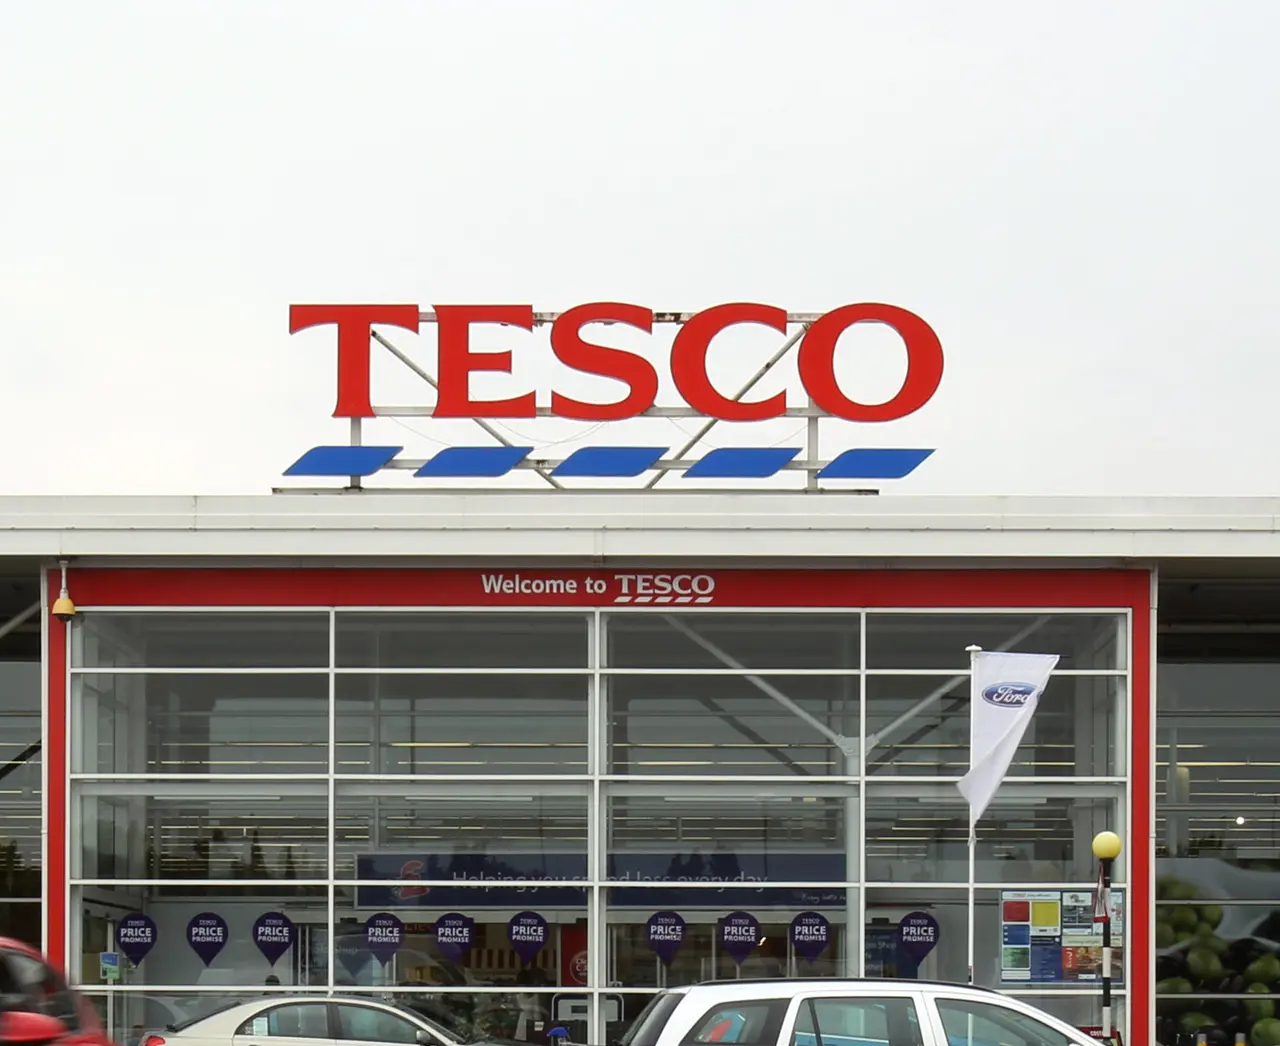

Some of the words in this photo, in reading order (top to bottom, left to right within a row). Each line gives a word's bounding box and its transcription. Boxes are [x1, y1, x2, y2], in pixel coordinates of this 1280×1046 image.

[289, 302, 944, 422] TESCO
[481, 574, 577, 594] Welcome
[584, 576, 606, 594] to
[614, 574, 715, 594] TESCO
[453, 872, 526, 892] Helping
[573, 871, 630, 892] spnd
[120, 928, 152, 937] PRICE
[192, 927, 223, 936] PRICE
[258, 927, 289, 936] PRICE
[368, 928, 400, 936] PRICE
[438, 928, 469, 936] PRICE
[512, 926, 544, 935] PRICE
[724, 927, 756, 935] PRICE
[795, 926, 826, 935] PRICE
[903, 927, 934, 936] PRICE
